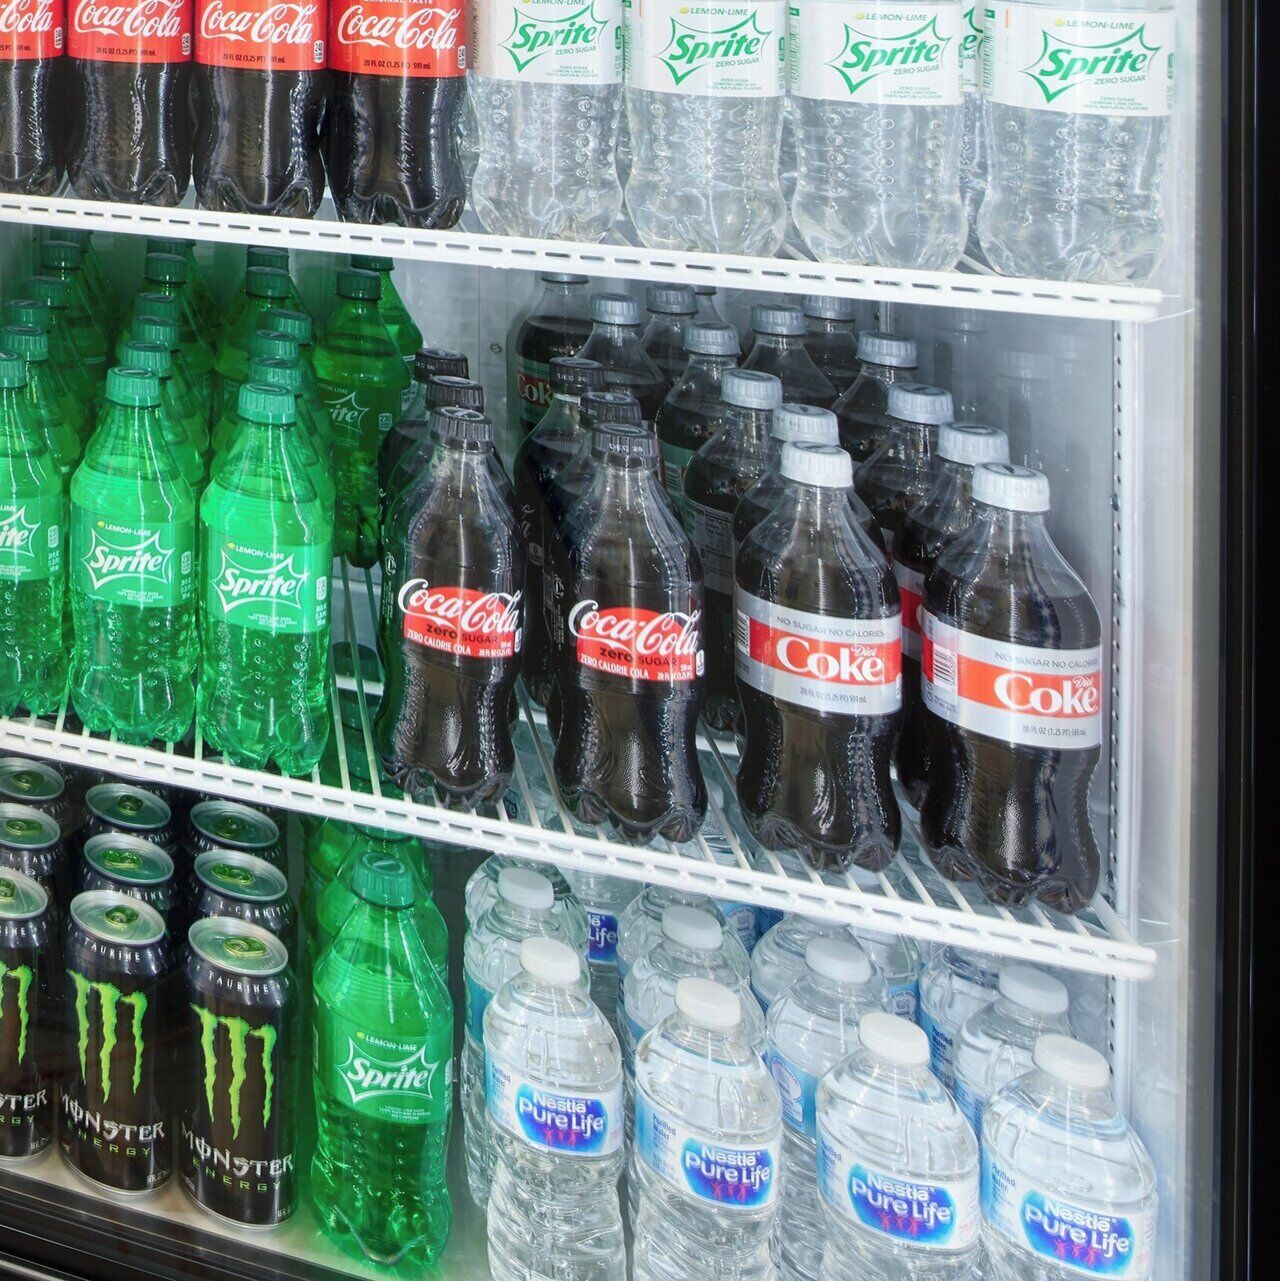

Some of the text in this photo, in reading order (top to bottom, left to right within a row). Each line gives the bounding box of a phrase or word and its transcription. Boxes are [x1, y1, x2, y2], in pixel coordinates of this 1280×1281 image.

[200, 0, 317, 47] Coca-Cola
[338, 6, 459, 50] Coca-Cola
[865, 13, 928, 22] LEMON-LIME
[667, 33, 760, 68] Sprite
[842, 42, 941, 72] Sprite
[1039, 48, 1147, 80] Sprite
[1094, 75, 1146, 85] ZERO SUGAR
[423, 635, 471, 654] CALORIE COLA
[427, 623, 498, 645] zero SUGAR
[638, 655, 677, 666] SUGAR
[776, 636, 884, 682] Coke
[994, 673, 1098, 714] Coke
[61, 1093, 165, 1143] MONSTER
[67, 1119, 151, 1157] ENERGY
